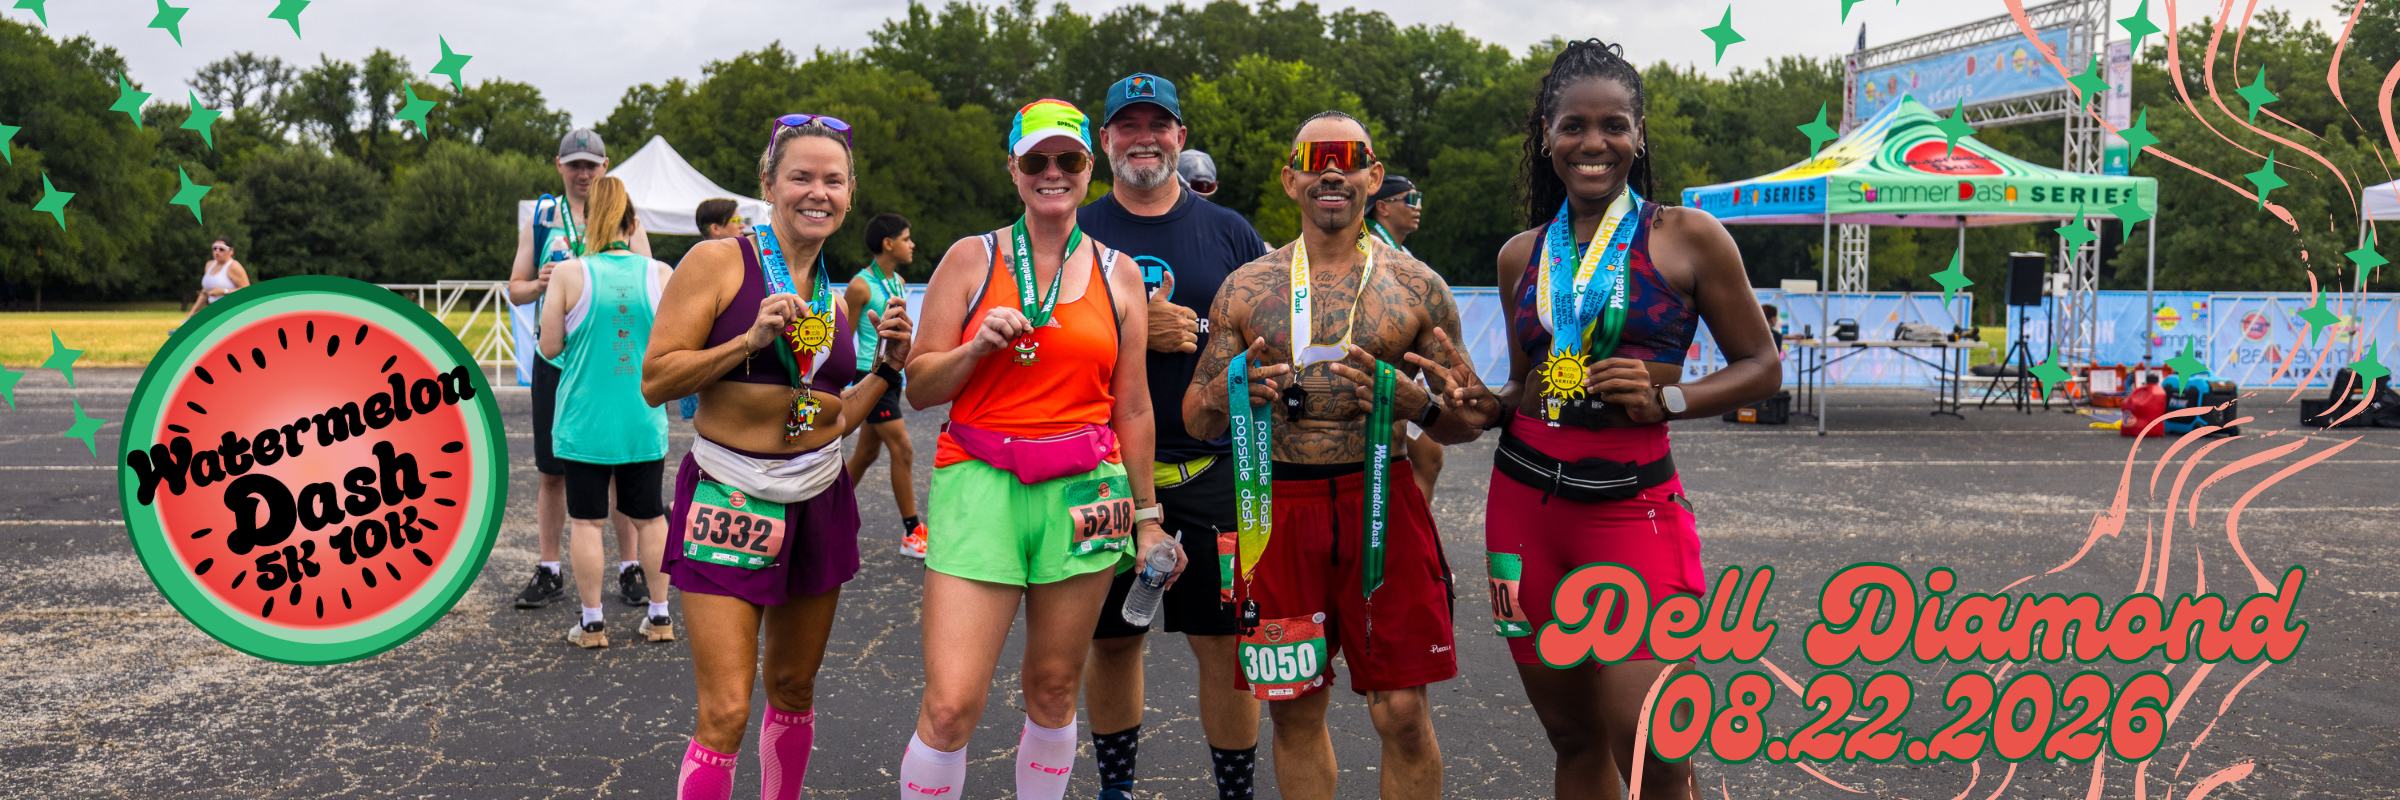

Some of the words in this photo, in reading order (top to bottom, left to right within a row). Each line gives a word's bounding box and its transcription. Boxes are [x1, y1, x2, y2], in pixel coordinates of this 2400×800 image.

[1764, 185, 1815, 203] SERIES
[1848, 180, 1953, 203] Summer
[1958, 180, 2018, 206] Dash
[2030, 186, 2134, 204] SERIES
[1017, 234, 1028, 256] Dash
[1550, 224, 1563, 272] Summer
[1561, 213, 1569, 247] SERIES
[1579, 216, 1620, 281] LEMONADE
[1607, 217, 1628, 248] SERIES
[775, 250, 789, 276] SERIES
[1294, 236, 1306, 288] EMONADE
[1604, 243, 1628, 271] Dash
[1024, 257, 1036, 306] Watermelon
[1294, 288, 1308, 313] Dash
[1232, 415, 1254, 481] popsicle
[1254, 421, 1271, 485] popsicle
[1373, 443, 1387, 517] Watermelon
[1080, 501, 1130, 538] 5248
[1240, 488, 1257, 530] dash
[1260, 493, 1272, 534] dash
[693, 507, 772, 552] 5332
[1371, 520, 1383, 547] Dash
[1244, 642, 1317, 681] 3050
[1030, 762, 1069, 776] cep
[908, 782, 951, 796] cep
